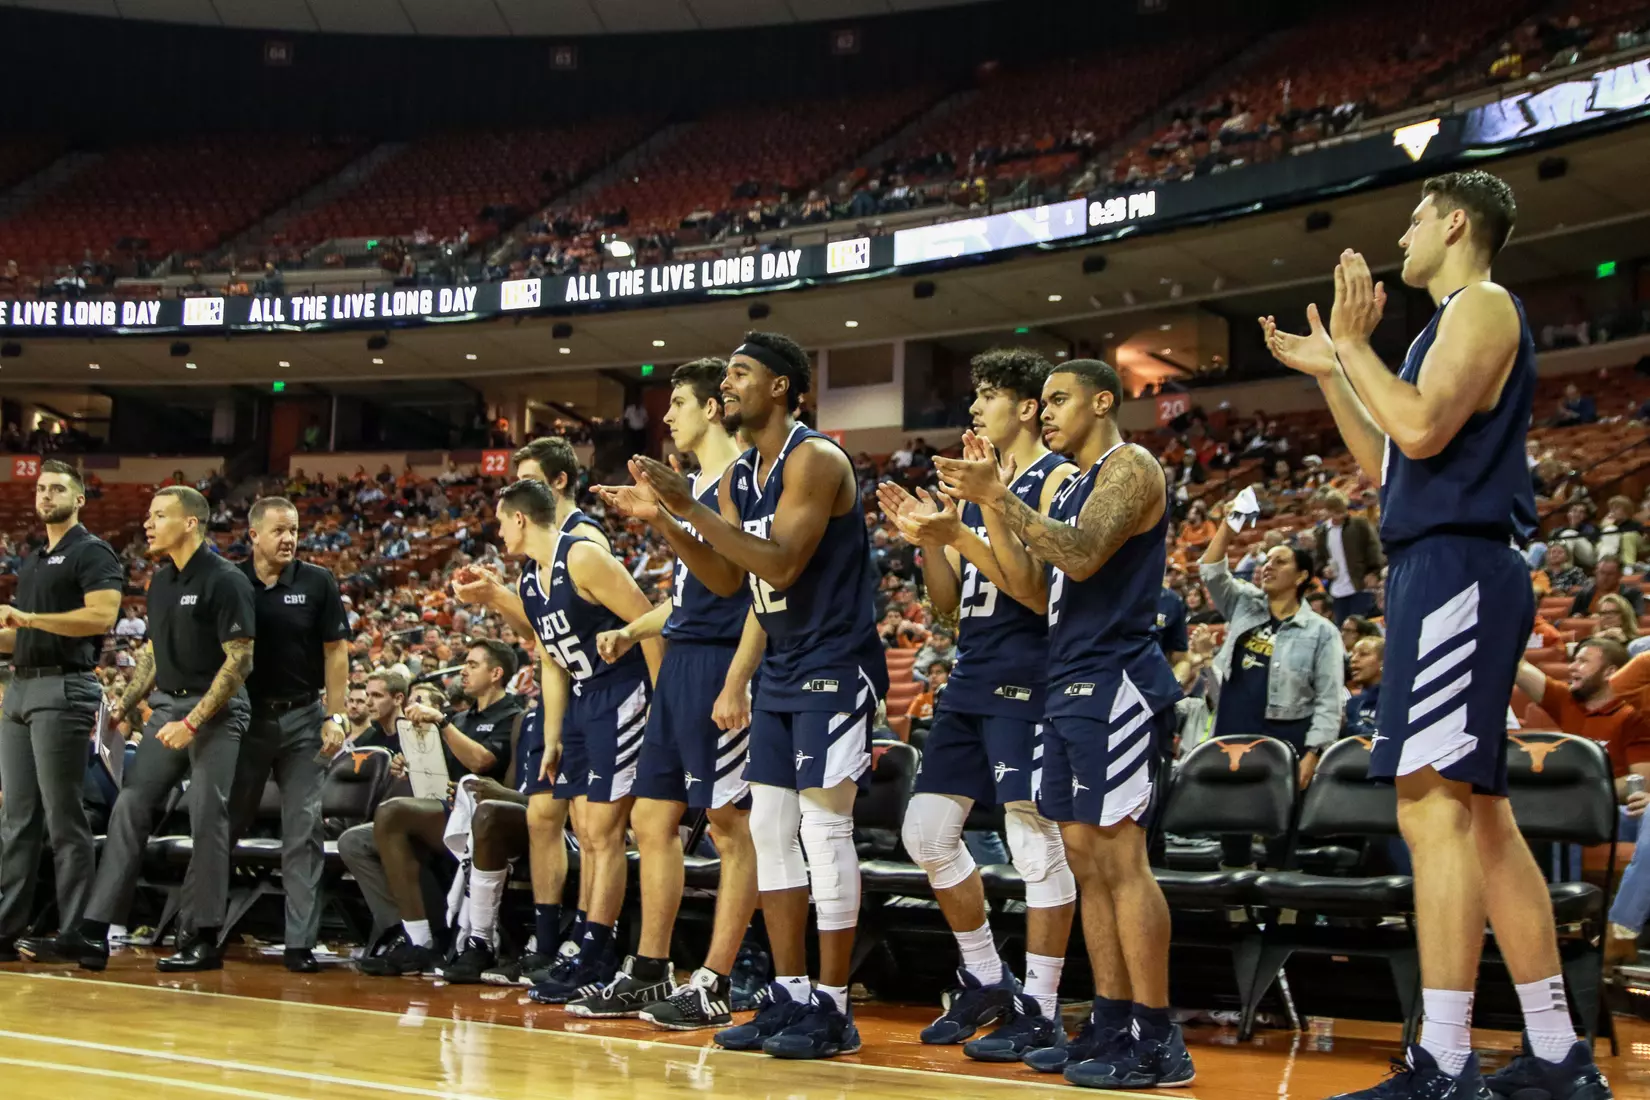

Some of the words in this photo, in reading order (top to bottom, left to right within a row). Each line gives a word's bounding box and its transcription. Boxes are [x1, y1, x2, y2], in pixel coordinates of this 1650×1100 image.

[1128, 190, 1156, 219] PM
[565, 275, 601, 302] ALL
[607, 269, 645, 297] THE
[651, 263, 696, 293] LIVE
[702, 258, 755, 288] LONG
[761, 249, 802, 280] DAY
[249, 298, 285, 322] ALL
[291, 296, 328, 321] THE
[332, 293, 376, 320] LIVE
[381, 289, 433, 317] LONG
[439, 286, 478, 313] DAY
[12, 301, 58, 325] LIVE
[63, 301, 117, 325] LONG
[122, 301, 161, 325] DAY
[1160, 400, 1185, 419] 20
[16, 460, 37, 476] 23
[486, 455, 505, 471] 22
[48, 555, 65, 565] CBU
[180, 594, 198, 606] CBU
[284, 594, 306, 604] CBU
[476, 724, 495, 732] CBU
